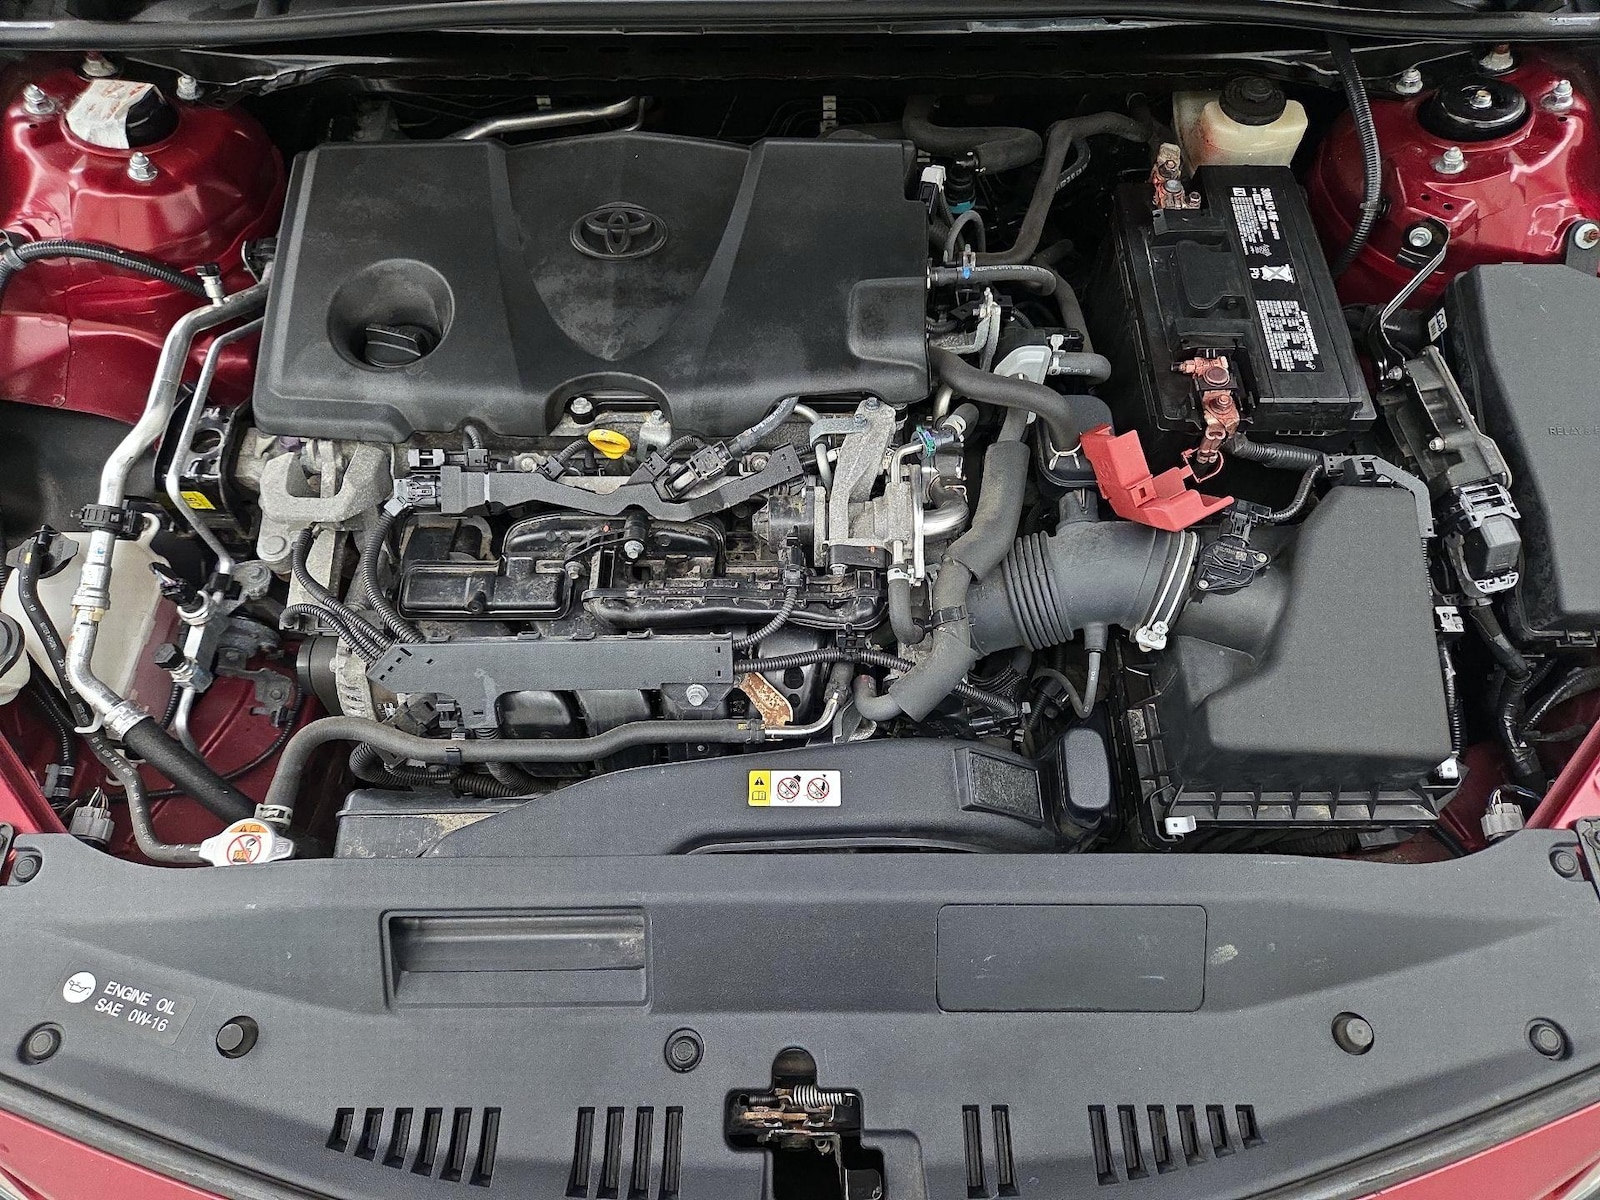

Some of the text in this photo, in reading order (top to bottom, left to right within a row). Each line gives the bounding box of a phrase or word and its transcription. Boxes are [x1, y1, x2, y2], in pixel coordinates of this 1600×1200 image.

[1249, 268, 1260, 279] Pb
[1548, 426, 1581, 436] RELAY
[104, 981, 175, 1015] ENGINE OIL
[94, 998, 169, 1032] SAE 0W-16
